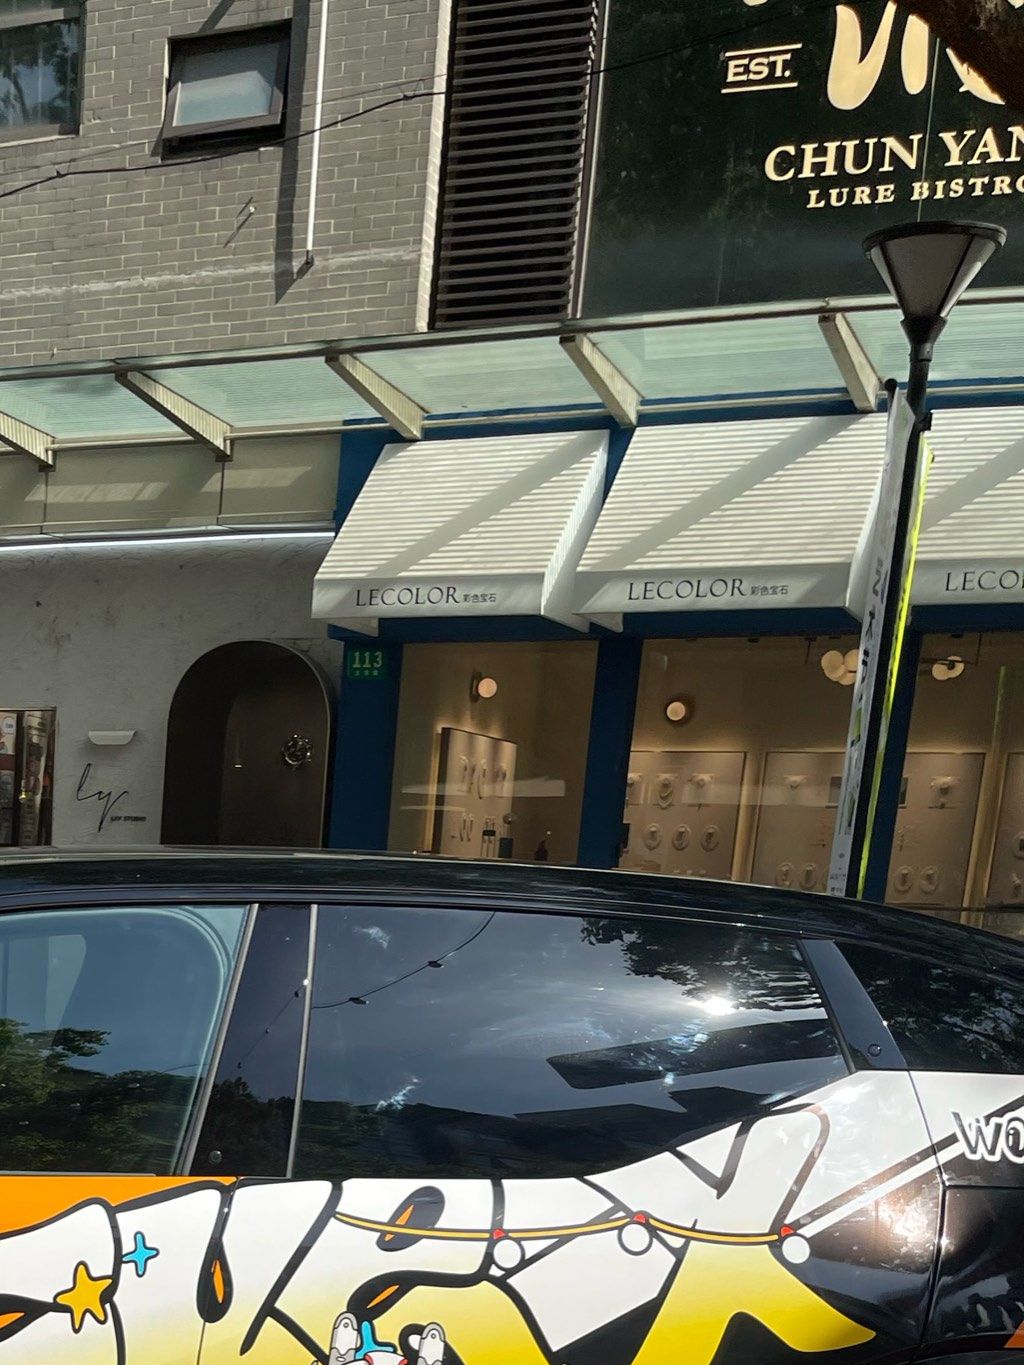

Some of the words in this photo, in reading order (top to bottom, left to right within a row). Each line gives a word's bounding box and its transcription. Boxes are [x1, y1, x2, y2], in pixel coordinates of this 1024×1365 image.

[726, 53, 791, 83] EST.
[764, 134, 924, 182] CHUN
[806, 184, 895, 209] LURE
[628, 578, 746, 601] LECOLOR
[945, 569, 1024, 592] LECO
[356, 586, 461, 606] LECOLOR
[352, 651, 383, 668] 113
